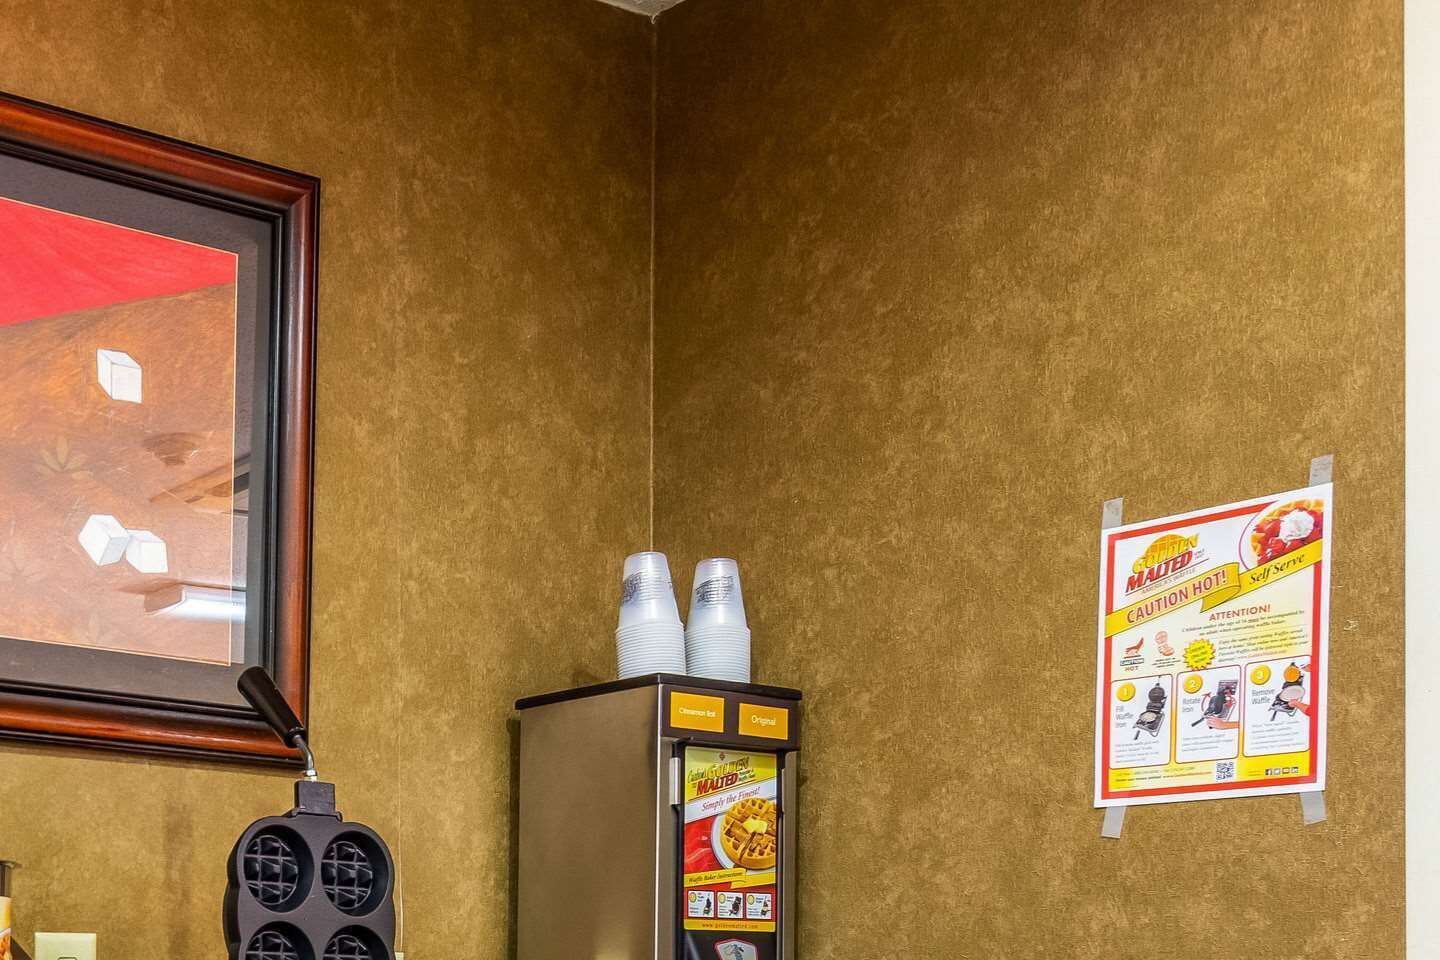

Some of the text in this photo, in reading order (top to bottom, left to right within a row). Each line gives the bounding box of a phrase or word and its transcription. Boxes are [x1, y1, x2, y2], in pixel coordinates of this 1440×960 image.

[1125, 550, 1193, 593] MALTED
[1249, 554, 1305, 585] Self Serve
[1127, 569, 1226, 623] CAUTION HOT!
[1209, 604, 1271, 621] ATTENTION!
[751, 715, 777, 727] Original
[696, 773, 739, 796] MALTED
[702, 787, 761, 812] Simply the Finest!
